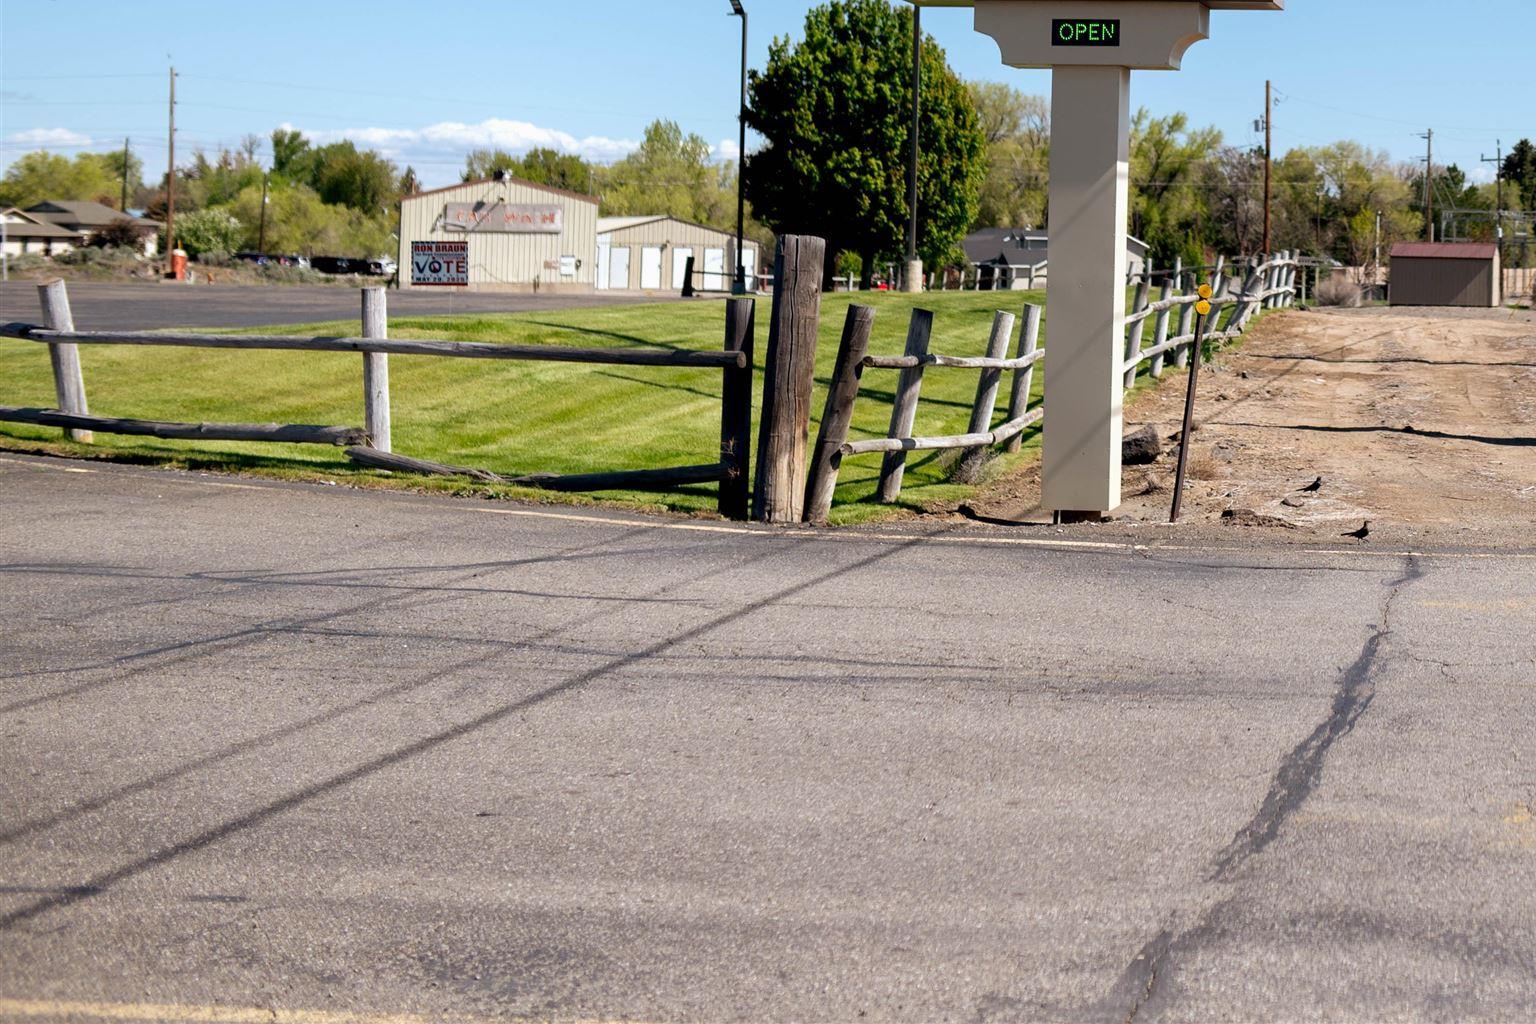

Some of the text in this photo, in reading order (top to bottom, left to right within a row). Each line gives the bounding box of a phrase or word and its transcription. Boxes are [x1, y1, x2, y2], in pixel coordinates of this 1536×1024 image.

[1059, 23, 1115, 41] OPEN
[414, 244, 466, 252] RON BRAUN
[414, 258, 466, 274] VOTE
